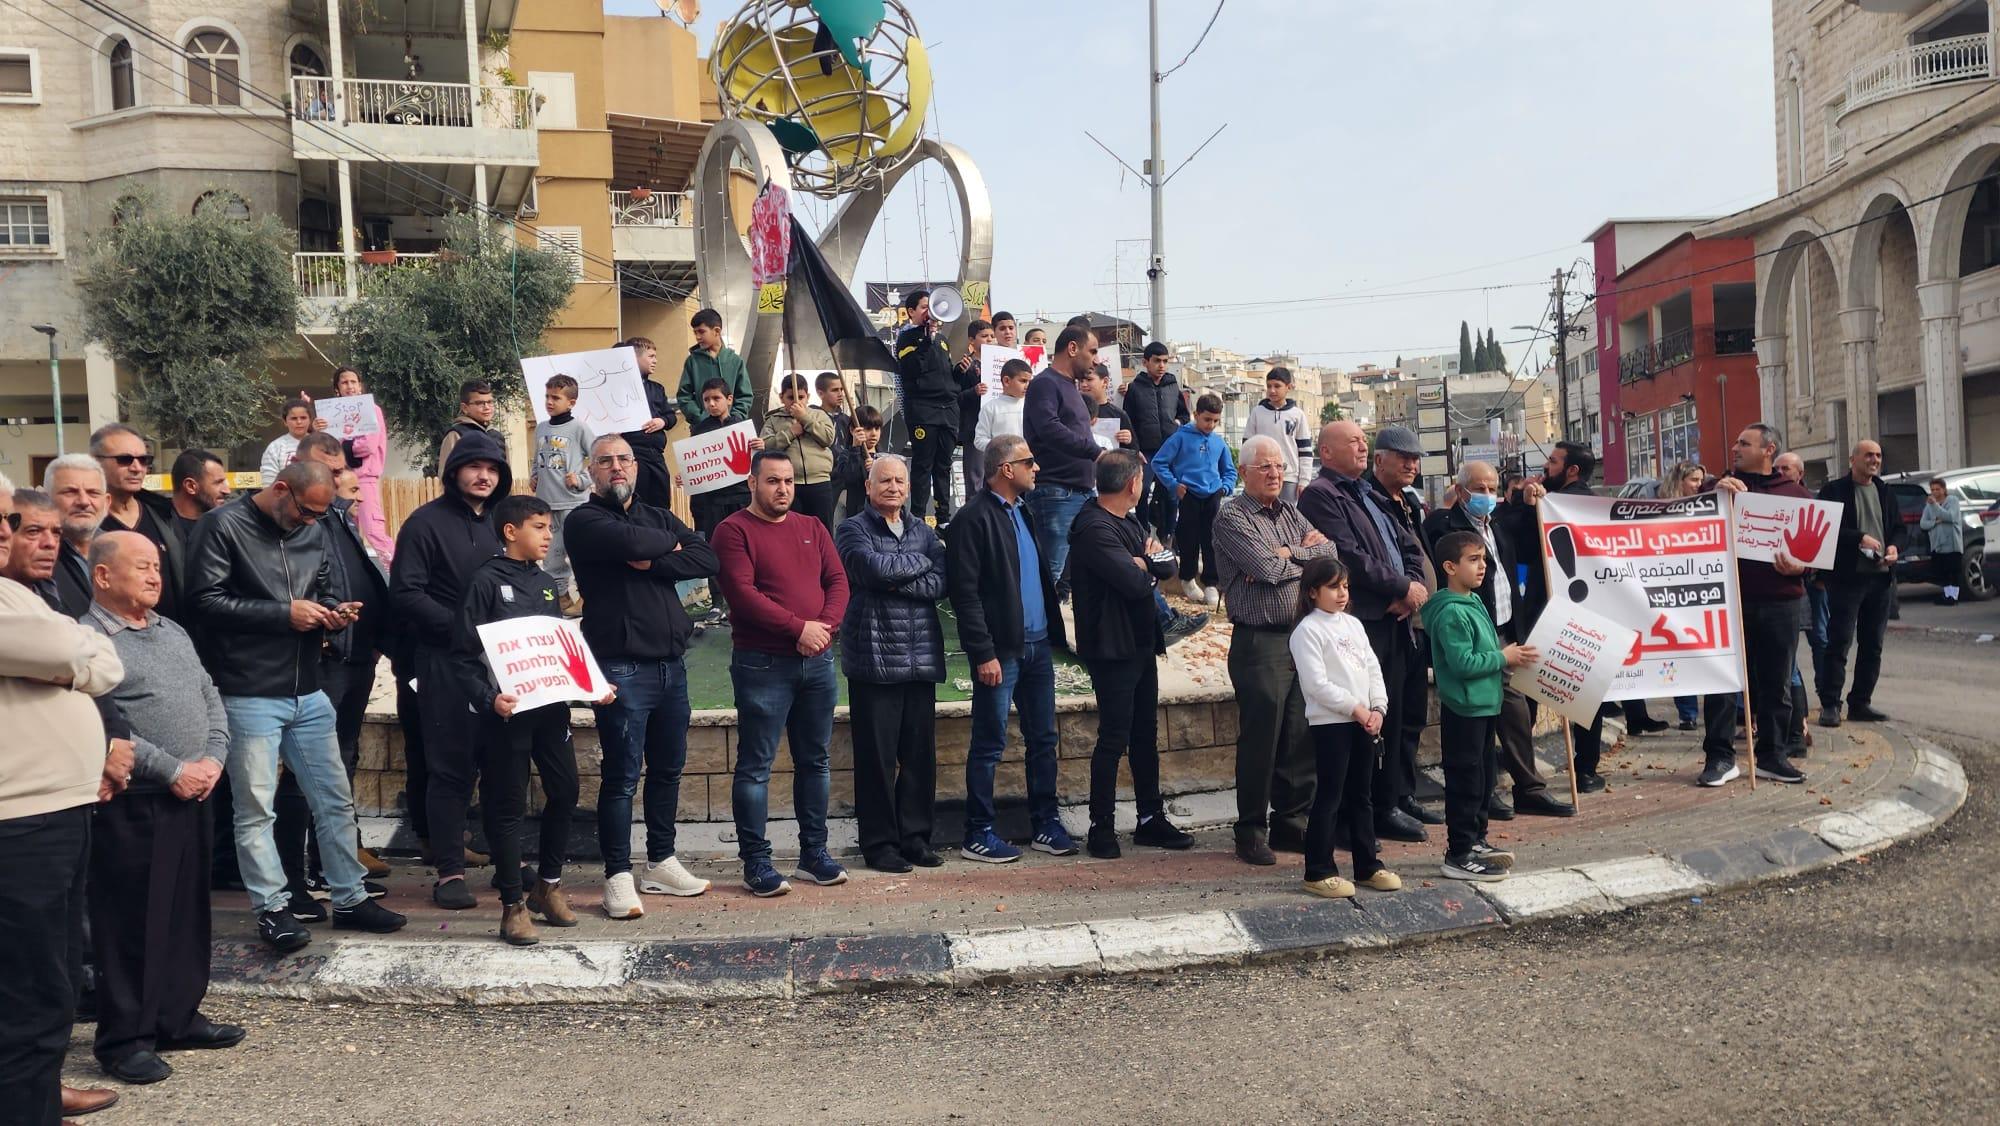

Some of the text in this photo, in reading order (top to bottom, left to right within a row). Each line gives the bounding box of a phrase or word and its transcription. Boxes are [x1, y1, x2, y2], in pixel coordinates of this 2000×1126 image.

[683, 442, 725, 461] עצרו את
[686, 457, 722, 474] מלחמת
[689, 470, 728, 487] הפשיעה
[1738, 522, 1782, 534] حرب
[1584, 523, 1721, 556] التصدي للجريمة
[1737, 531, 1783, 551] الجريمة
[1594, 558, 1724, 585] في المجتمع العربي
[1649, 587, 1722, 607] هو من واجب
[1560, 628, 1602, 652] הממשלה
[1567, 617, 1608, 642] الحكومة
[497, 634, 556, 655] עצרו את
[505, 654, 558, 676] מלחמת
[1548, 647, 1593, 673] והמשטרה
[513, 674, 571, 697] הפשיעה
[1538, 668, 1581, 692] שותפות
[1540, 687, 1566, 705] לפשע
